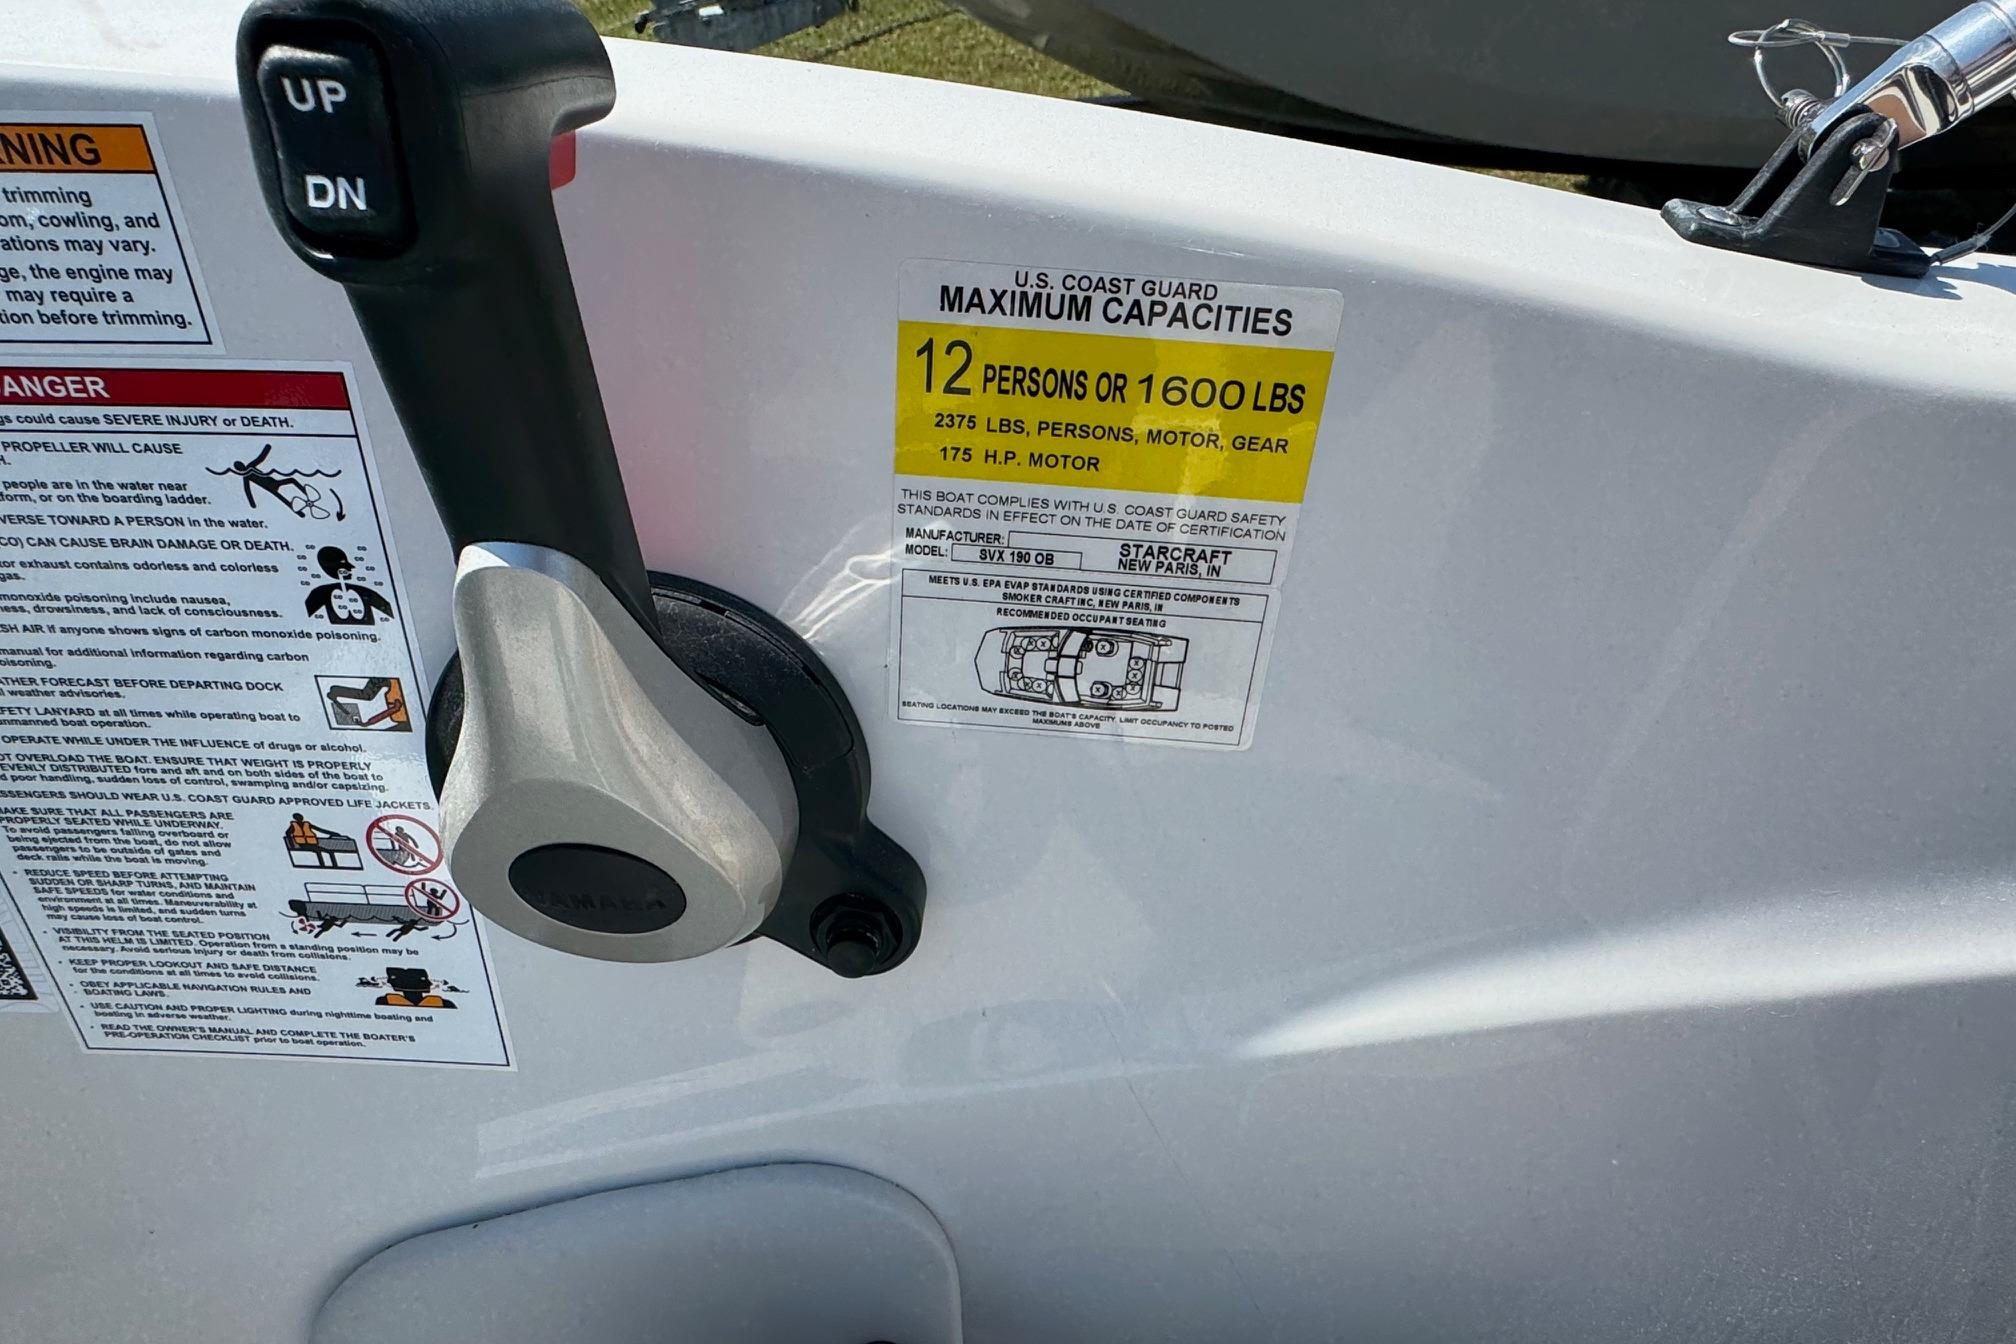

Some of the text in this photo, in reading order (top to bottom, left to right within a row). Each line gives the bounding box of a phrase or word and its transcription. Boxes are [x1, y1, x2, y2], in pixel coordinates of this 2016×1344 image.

[280, 76, 347, 115] UP
[0, 132, 102, 167] NING
[1, 186, 92, 207] trimming
[304, 173, 368, 212] DN
[36, 211, 119, 231] cowling,
[123, 212, 160, 228] and
[63, 239, 103, 255] may
[108, 239, 155, 255] vary.
[28, 263, 61, 279] the
[65, 264, 129, 283] engine
[133, 268, 172, 284] may
[1014, 270, 1217, 300] U.S. COAST GUARD
[4, 287, 134, 305] may require a
[36, 309, 98, 324] before
[101, 310, 192, 328] trimming.
[939, 285, 1292, 335] MAXIMUM CAPACITIES
[915, 336, 1305, 413] 12 PERSONS OR 1600 LBS
[0, 374, 111, 399] ANGER
[15, 413, 55, 424] could
[58, 416, 100, 424] cause
[102, 413, 163, 425] SEVERE
[164, 414, 217, 426] INJURY
[222, 417, 236, 426] or
[239, 415, 293, 427] DEATH.
[934, 412, 1288, 453] 2375 LBS, PERSONS, MOTOR, GEAR
[0, 441, 183, 454] PROPELLER WILL CAUSE
[939, 446, 1099, 471] 175 H.P. MOTOR
[1, 479, 187, 491] people are in the water near
[38, 494, 52, 502] or
[56, 494, 75, 502] on
[76, 492, 99, 502] the
[100, 493, 163, 506] boarding
[164, 493, 211, 504] ladder.
[900, 488, 931, 500] THIS
[936, 490, 974, 503] BOAT
[977, 494, 1049, 509] COMPLIES
[1053, 499, 1089, 511] WITH
[1124, 504, 1174, 517] COAST
[1176, 508, 1227, 522] GUARD
[1230, 512, 1286, 525] SAFETY
[46, 514, 110, 525] TOWARD
[113, 515, 124, 526] A
[124, 515, 185, 526] PERSON
[186, 516, 201, 527] in
[203, 517, 225, 527] the
[227, 518, 267, 528] water.
[896, 503, 1286, 540] STANDARDS IN EFFECT ON THE DATE OF CERTIFICATION
[25, 536, 57, 547] CAN
[58, 537, 108, 547] CAUSE
[109, 537, 154, 548] BRAIN
[155, 538, 217, 549] DAMAGE
[220, 539, 242, 550] OR
[243, 540, 294, 551] DEATH.
[905, 527, 1008, 547] MANUFACTURER:
[904, 543, 1054, 565] MODEL: SVX 190 OB
[1118, 542, 1233, 566] STARCRAFT
[1117, 557, 1222, 578] NEW PARIS, IN
[928, 574, 1240, 605] MEETS U.S. EPA EVAP STANDARDS USING CERTIFIED COMPONENTS
[1001, 591, 1042, 602] SMOKER
[1044, 594, 1076, 605] CRAFT
[1097, 598, 1120, 608] NEW
[1153, 603, 1163, 612] IN
[996, 607, 1166, 627] RECOMMENDED OCCUPANT SEATING
[901, 700, 934, 708] SEATING
[1032, 717, 1100, 729] MAXIMUMS ABOVE
[0, 735, 61, 744] OPERATE
[61, 736, 104, 745] WHILE
[104, 736, 151, 746] UNDER
[150, 737, 178, 747] THE
[179, 738, 251, 749] INFLUENCE
[252, 740, 264, 749] of
[267, 741, 302, 752] drugs
[320, 743, 366, 752] alcohol.
[68, 791, 119, 800] SHOULD
[120, 792, 159, 801] WEAR
[160, 793, 185, 801] U.S.
[187, 794, 228, 803] COAST
[231, 795, 275, 804] GUARD
[278, 796, 343, 806] APPROVED
[346, 799, 372, 808] LIFE
[68, 958, 318, 974] KEEP PROPER LOOKOUT AND SAFE DISTANCE
